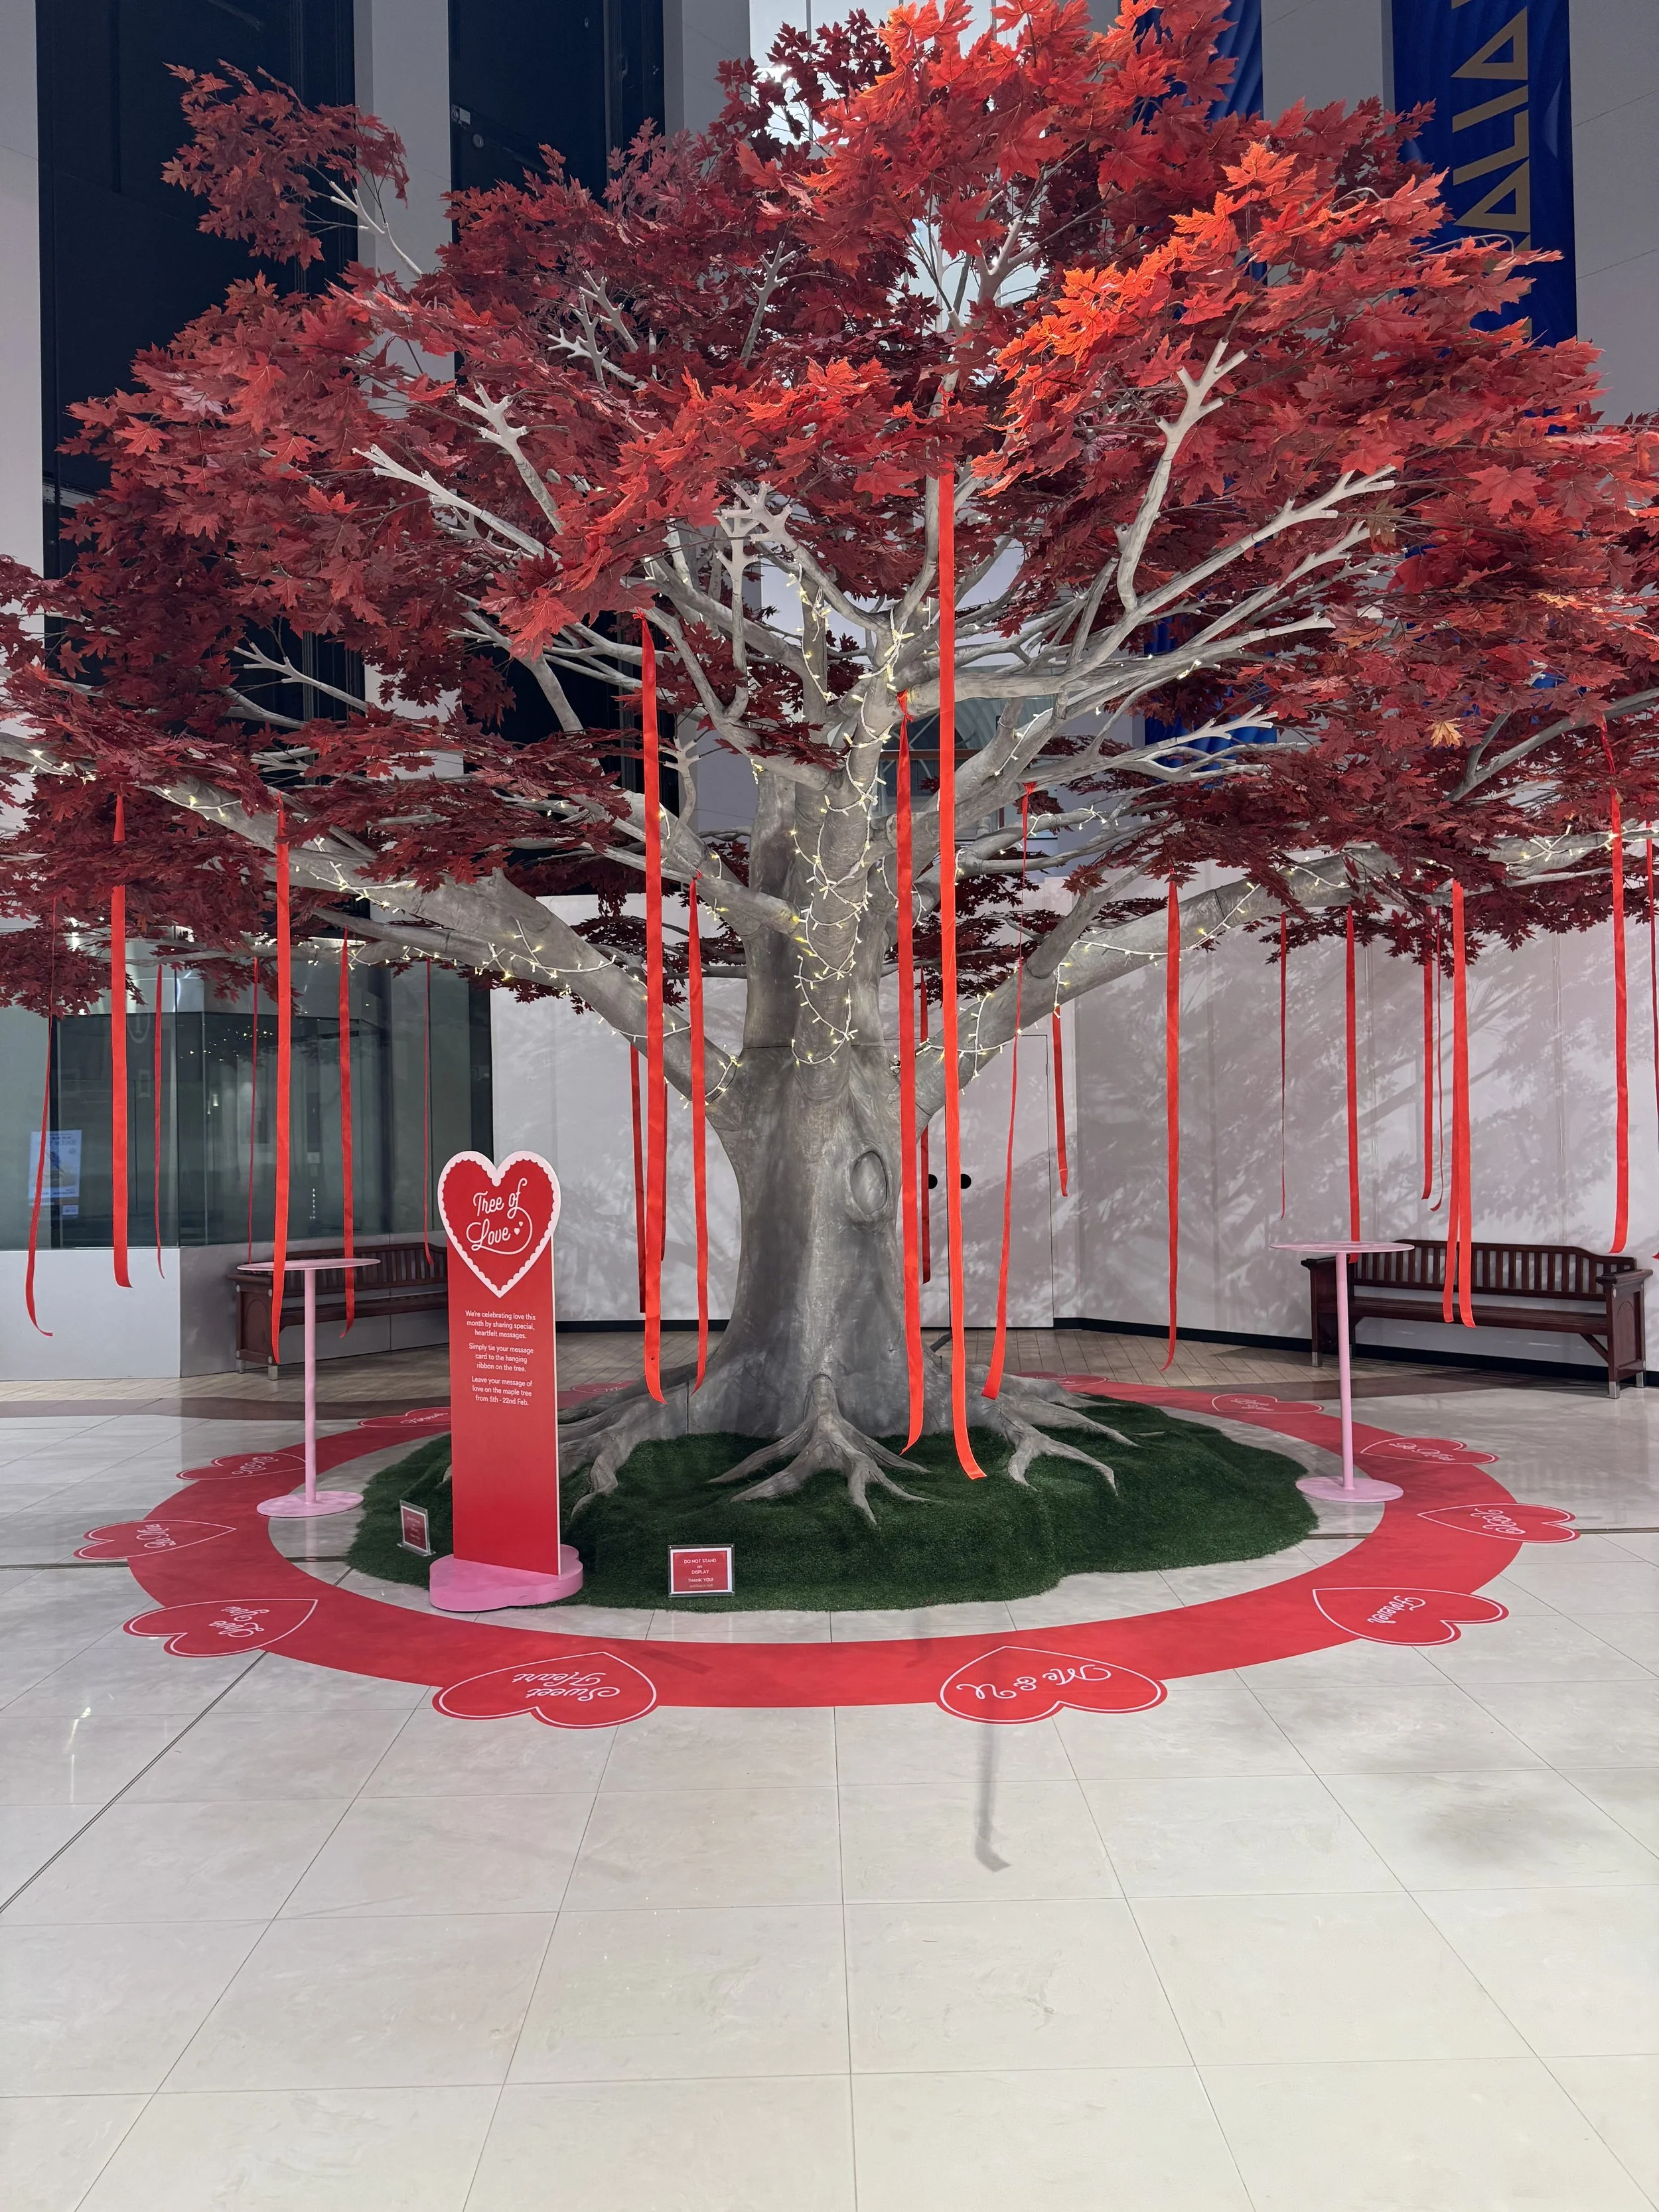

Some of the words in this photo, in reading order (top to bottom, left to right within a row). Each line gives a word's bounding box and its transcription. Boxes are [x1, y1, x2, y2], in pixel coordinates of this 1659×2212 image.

[473, 1191, 504, 1217] Tree
[507, 1177, 529, 1219] of
[467, 1218, 512, 1252] Love
[482, 1311, 512, 1320] celebrating
[493, 1321, 512, 1330] sharing
[469, 1343, 487, 1352] Simply
[506, 1355, 528, 1364] hanging
[220, 1606, 270, 1622] You
[1367, 1595, 1426, 1624] Forever
[208, 1621, 265, 1638] Love
[512, 1671, 607, 1687] Heart
[1042, 1664, 1112, 1686] Me
[956, 1683, 1017, 1700] U
[1013, 1676, 1037, 1692] &
[525, 1686, 620, 1702] Sweet
